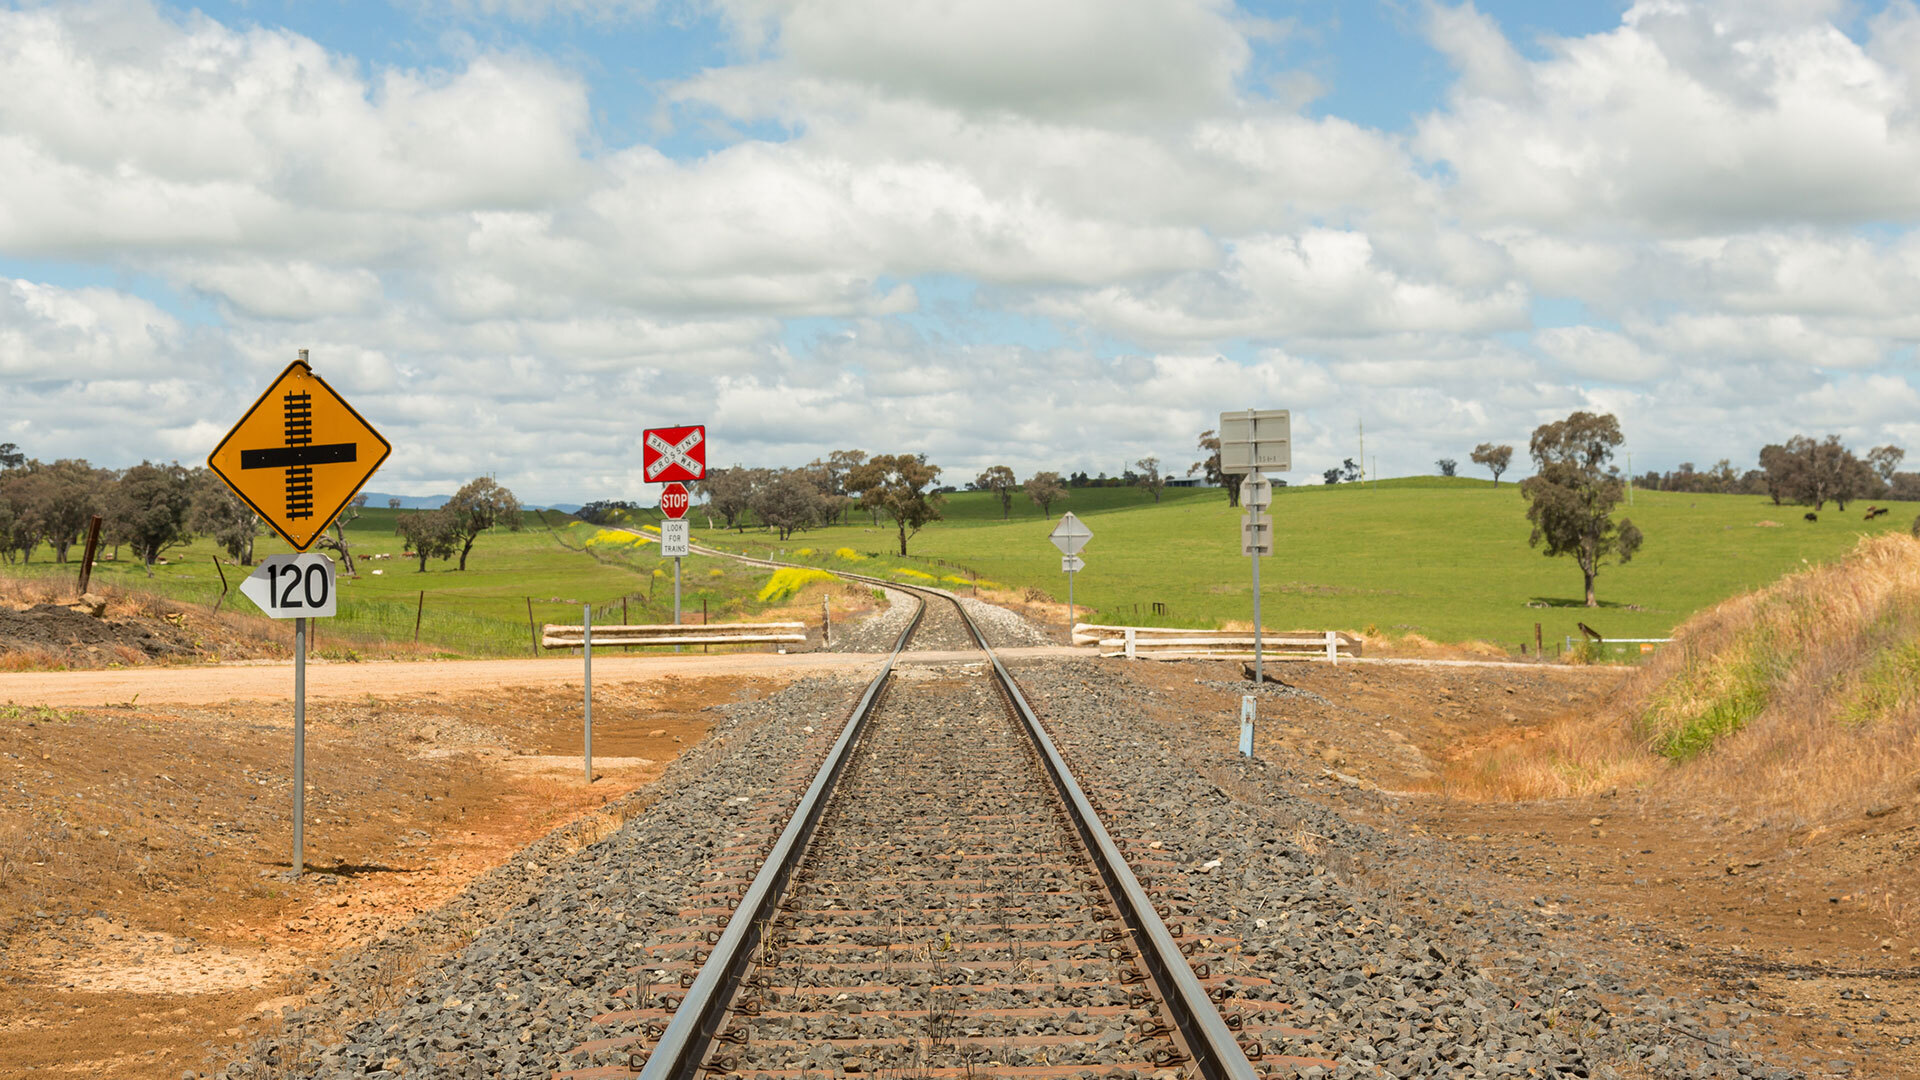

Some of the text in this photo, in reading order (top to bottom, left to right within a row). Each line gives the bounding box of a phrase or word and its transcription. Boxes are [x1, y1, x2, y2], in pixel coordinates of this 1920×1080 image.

[652, 434, 698, 473] CROSSING
[663, 494, 687, 508] STOP
[667, 524, 682, 532] LOOK
[669, 534, 681, 542] FOR
[267, 563, 328, 608] 120
